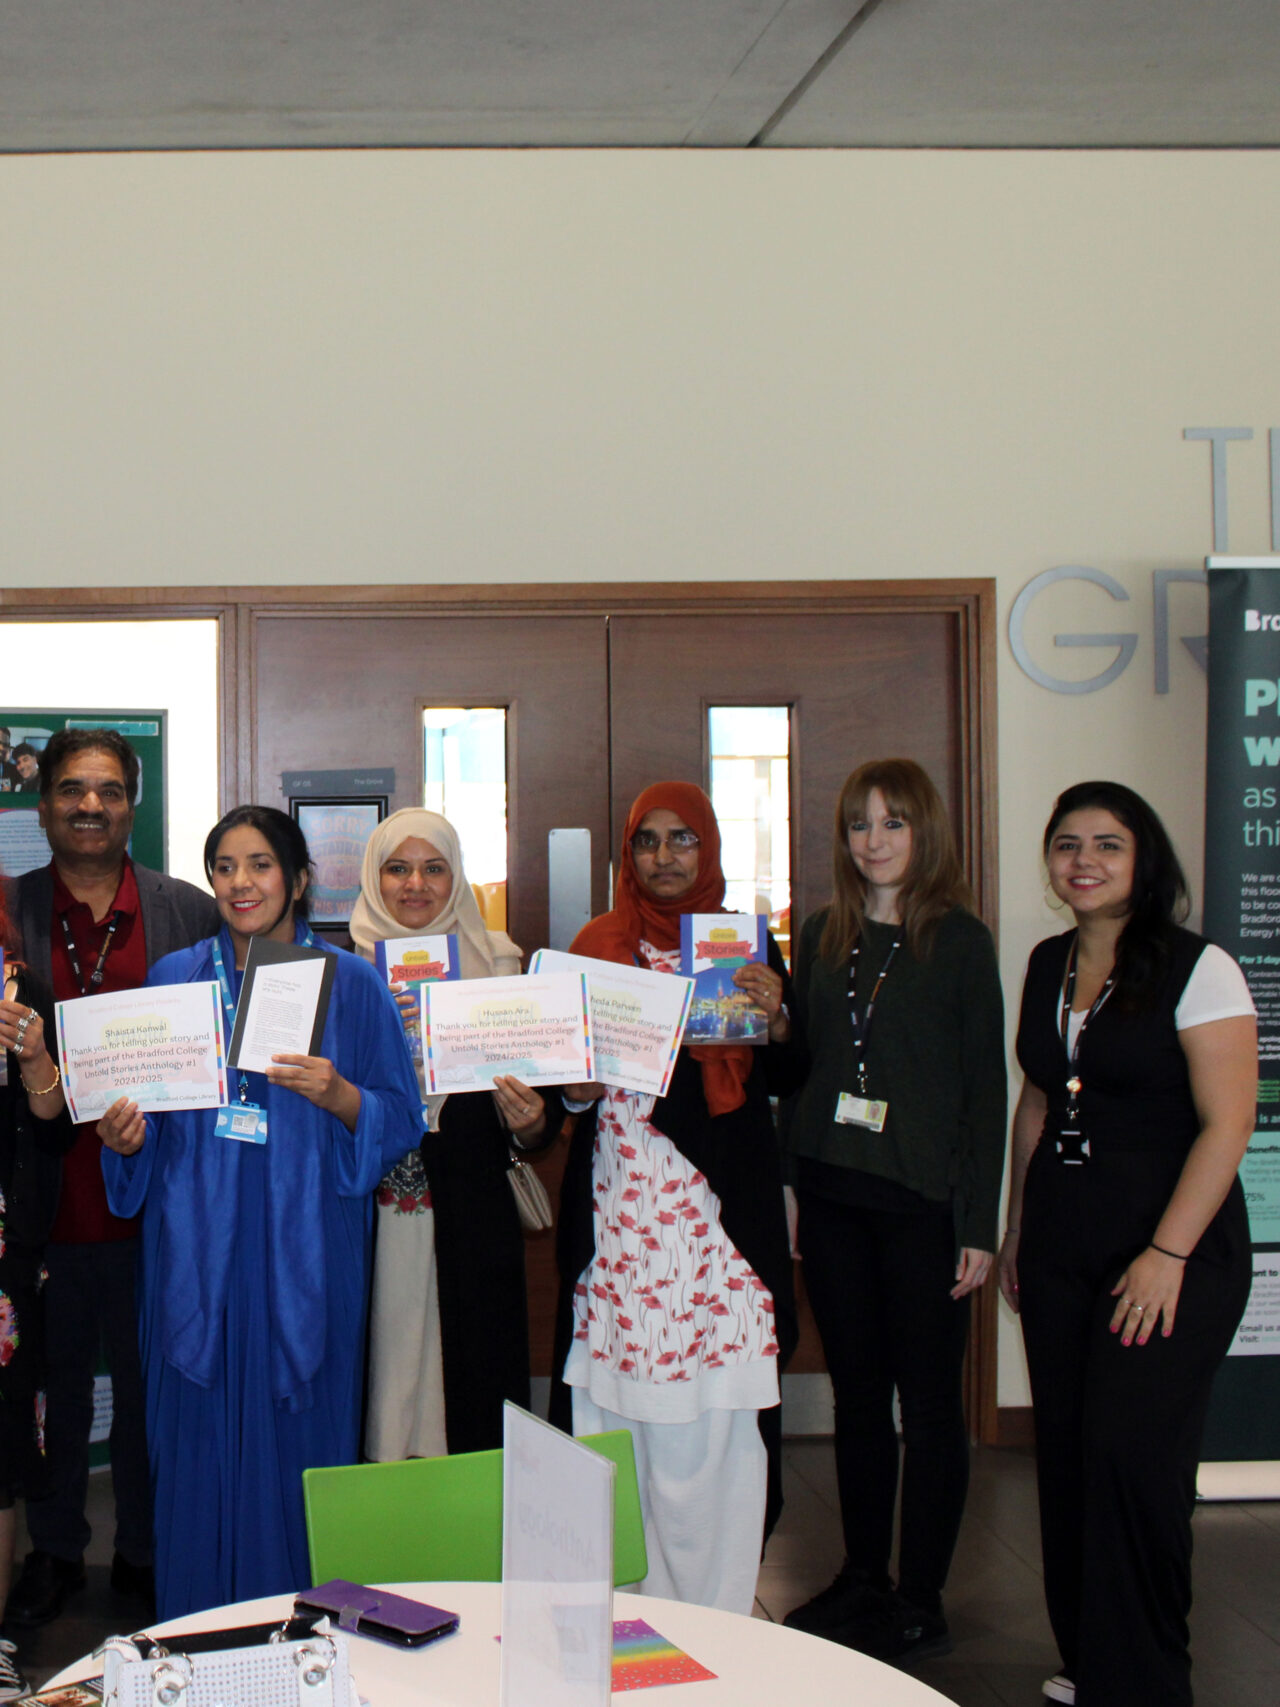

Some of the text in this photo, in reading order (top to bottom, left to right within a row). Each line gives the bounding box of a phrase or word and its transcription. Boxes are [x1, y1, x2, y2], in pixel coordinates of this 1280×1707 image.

[1182, 427, 1280, 552] T
[1245, 679, 1280, 717] P
[1243, 787, 1277, 808] as
[312, 815, 370, 837] SORRY
[1242, 873, 1276, 882] We are
[1241, 887, 1258, 896] this
[314, 901, 331, 913] HIS
[1241, 901, 1265, 910] to be
[1240, 928, 1274, 939] Energy
[704, 944, 746, 954] Stories
[398, 966, 439, 978] Stories
[436, 1022, 461, 1031] Thank
[463, 1021, 478, 1030] you
[479, 1020, 490, 1028] for
[492, 1018, 518, 1028] telling
[519, 1017, 538, 1026] your
[539, 1016, 560, 1025] story
[593, 1009, 618, 1022] telling
[618, 1016, 636, 1024] your
[637, 1019, 656, 1030] story
[105, 1023, 167, 1037] Shaista Kanwal
[439, 1027, 576, 1042] being part of the Bradford College
[605, 1022, 667, 1044] Bradford College
[71, 1033, 210, 1056] Thank you for telling your story and
[451, 1038, 565, 1052] Untold Stories Anthology #1
[604, 1035, 653, 1053] Anthology #1
[74, 1046, 208, 1069] being part of the Bradford College
[485, 1052, 532, 1062] 2024/2025
[85, 1059, 196, 1079] Untold Stories Anthology #1
[114, 1074, 163, 1086] 2024/2025
[1251, 1269, 1279, 1277] ant to
[1240, 1324, 1263, 1332] Email
